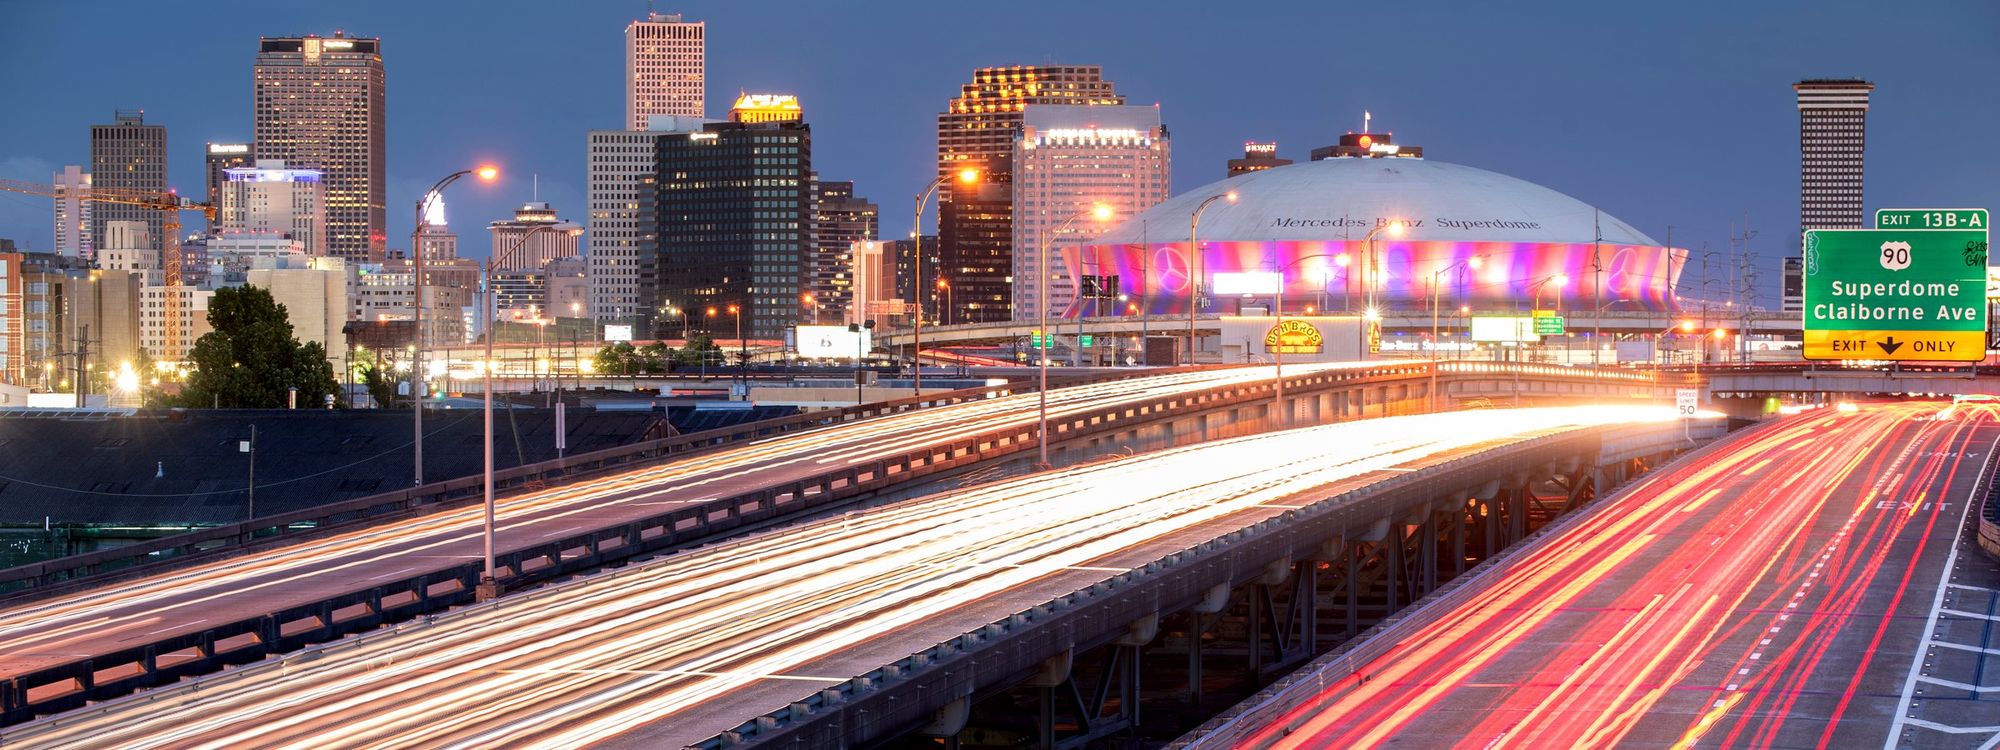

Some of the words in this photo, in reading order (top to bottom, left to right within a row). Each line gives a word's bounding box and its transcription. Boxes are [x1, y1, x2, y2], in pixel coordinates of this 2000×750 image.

[1251, 144, 1276, 152] HYATT
[1436, 217, 1541, 230] Superdome
[1882, 215, 1911, 225] EXIT
[1922, 212, 1982, 227] 13B-A
[1883, 248, 1908, 265] 90
[1831, 280, 1960, 300] Superdome
[1814, 303, 1924, 320] Claiborne
[1936, 305, 1977, 320] Ave
[1833, 340, 1867, 351] EXIT
[1913, 340, 1956, 352] ONLY
[1679, 405, 1695, 415] 50
[1876, 501, 1953, 512] EXIT
